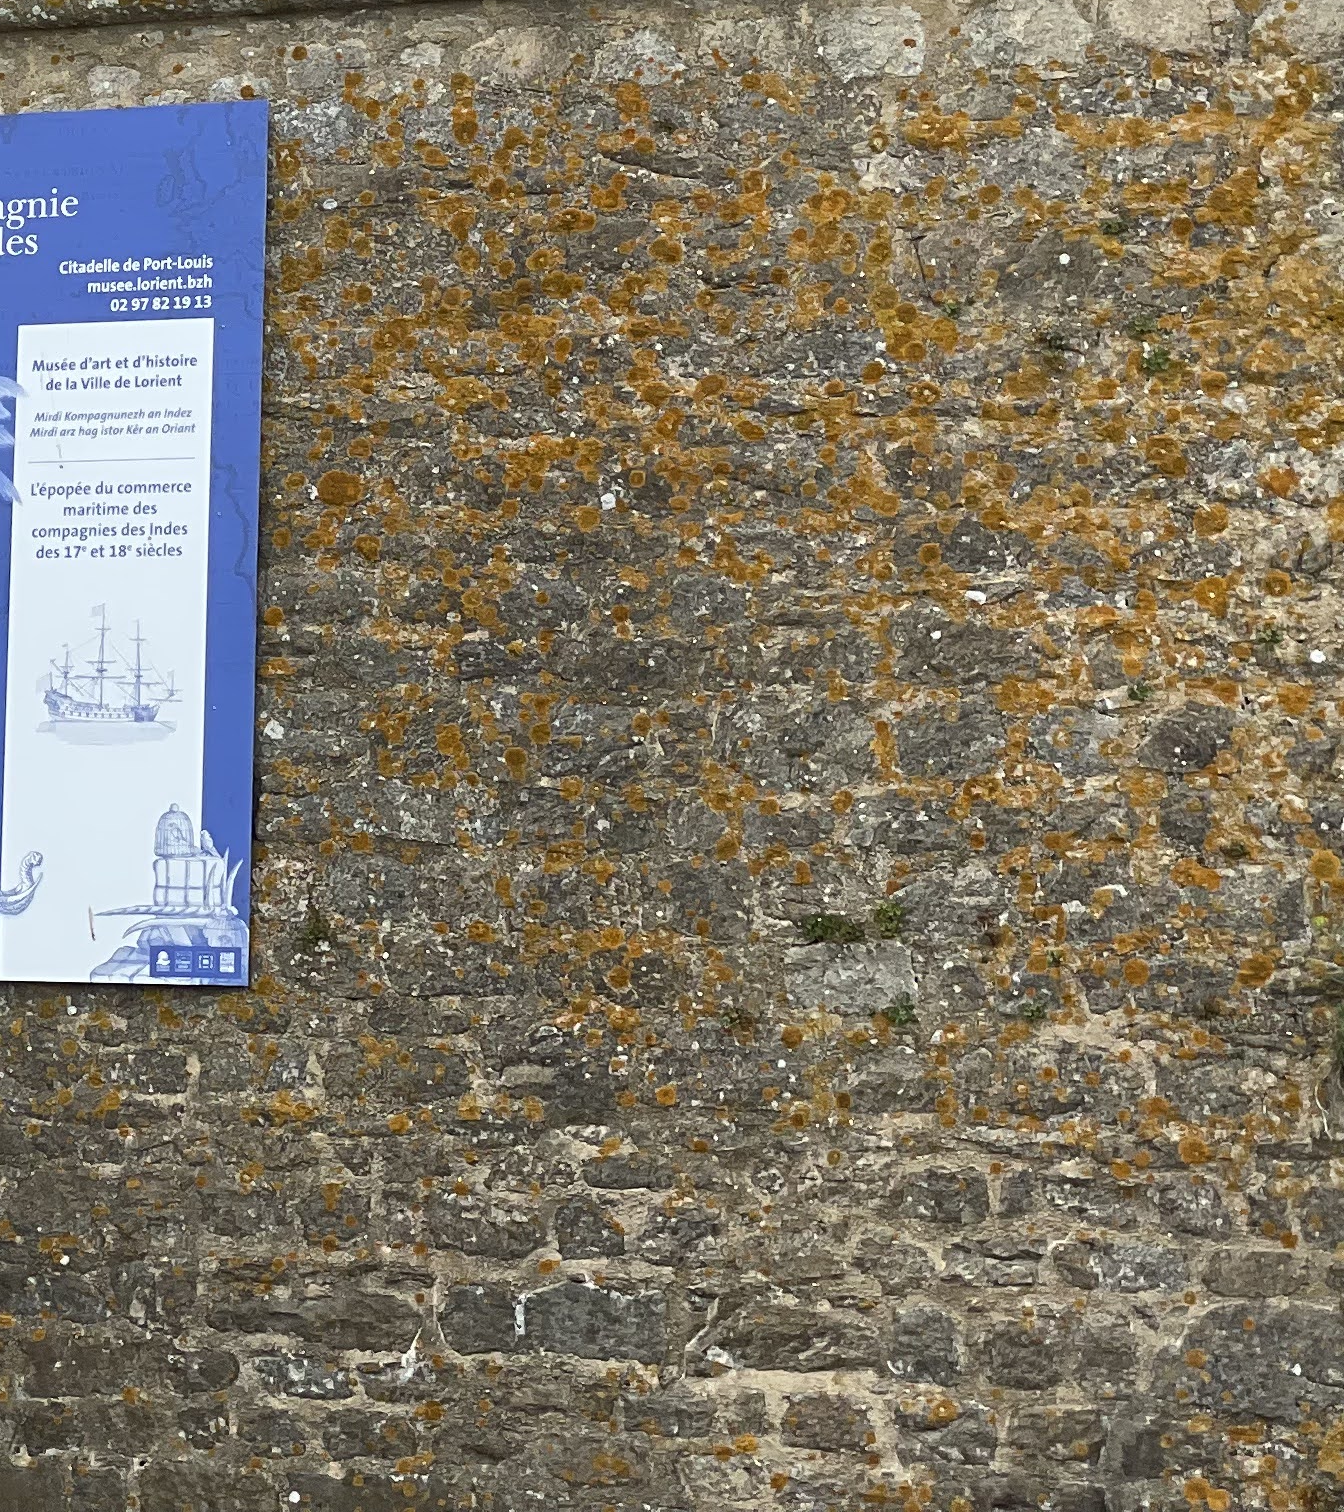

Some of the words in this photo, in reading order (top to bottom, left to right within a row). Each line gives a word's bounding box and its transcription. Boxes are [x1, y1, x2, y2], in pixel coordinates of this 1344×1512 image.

[59, 259, 120, 274] Citadelle
[123, 258, 140, 272] de
[144, 255, 213, 271] Port-Louis
[88, 274, 212, 293] musee.lorient.bzh
[110, 299, 128, 312] 02
[132, 298, 149, 311] 97
[152, 297, 170, 310] 82
[173, 296, 191, 309] 19
[194, 295, 212, 308] 13
[32, 358, 77, 372] Musée
[115, 357, 129, 369] et
[46, 378, 62, 391] de
[66, 378, 77, 390] la
[81, 377, 111, 389] Ville
[115, 376, 131, 388] de
[135, 375, 183, 388] Lorient
[34, 411, 62, 423] Mirdi
[64, 409, 145, 423] Kompagnunezh
[148, 411, 161, 419] an
[164, 408, 192, 418] Indez
[30, 427, 58, 438] Mirdi
[60, 429, 76, 437] arz
[78, 426, 98, 439] hag
[101, 426, 124, 436] istor
[162, 423, 196, 434] Oriant
[95, 481, 113, 495] du
[117, 482, 192, 494] commerce
[63, 502, 129, 517] maritime
[133, 501, 158, 515] des
[32, 523, 117, 541] compagnies
[121, 522, 146, 536] des
[150, 521, 188, 536] Indes
[36, 546, 60, 559] des
[91, 546, 105, 558] et
[136, 543, 183, 558] siècles
